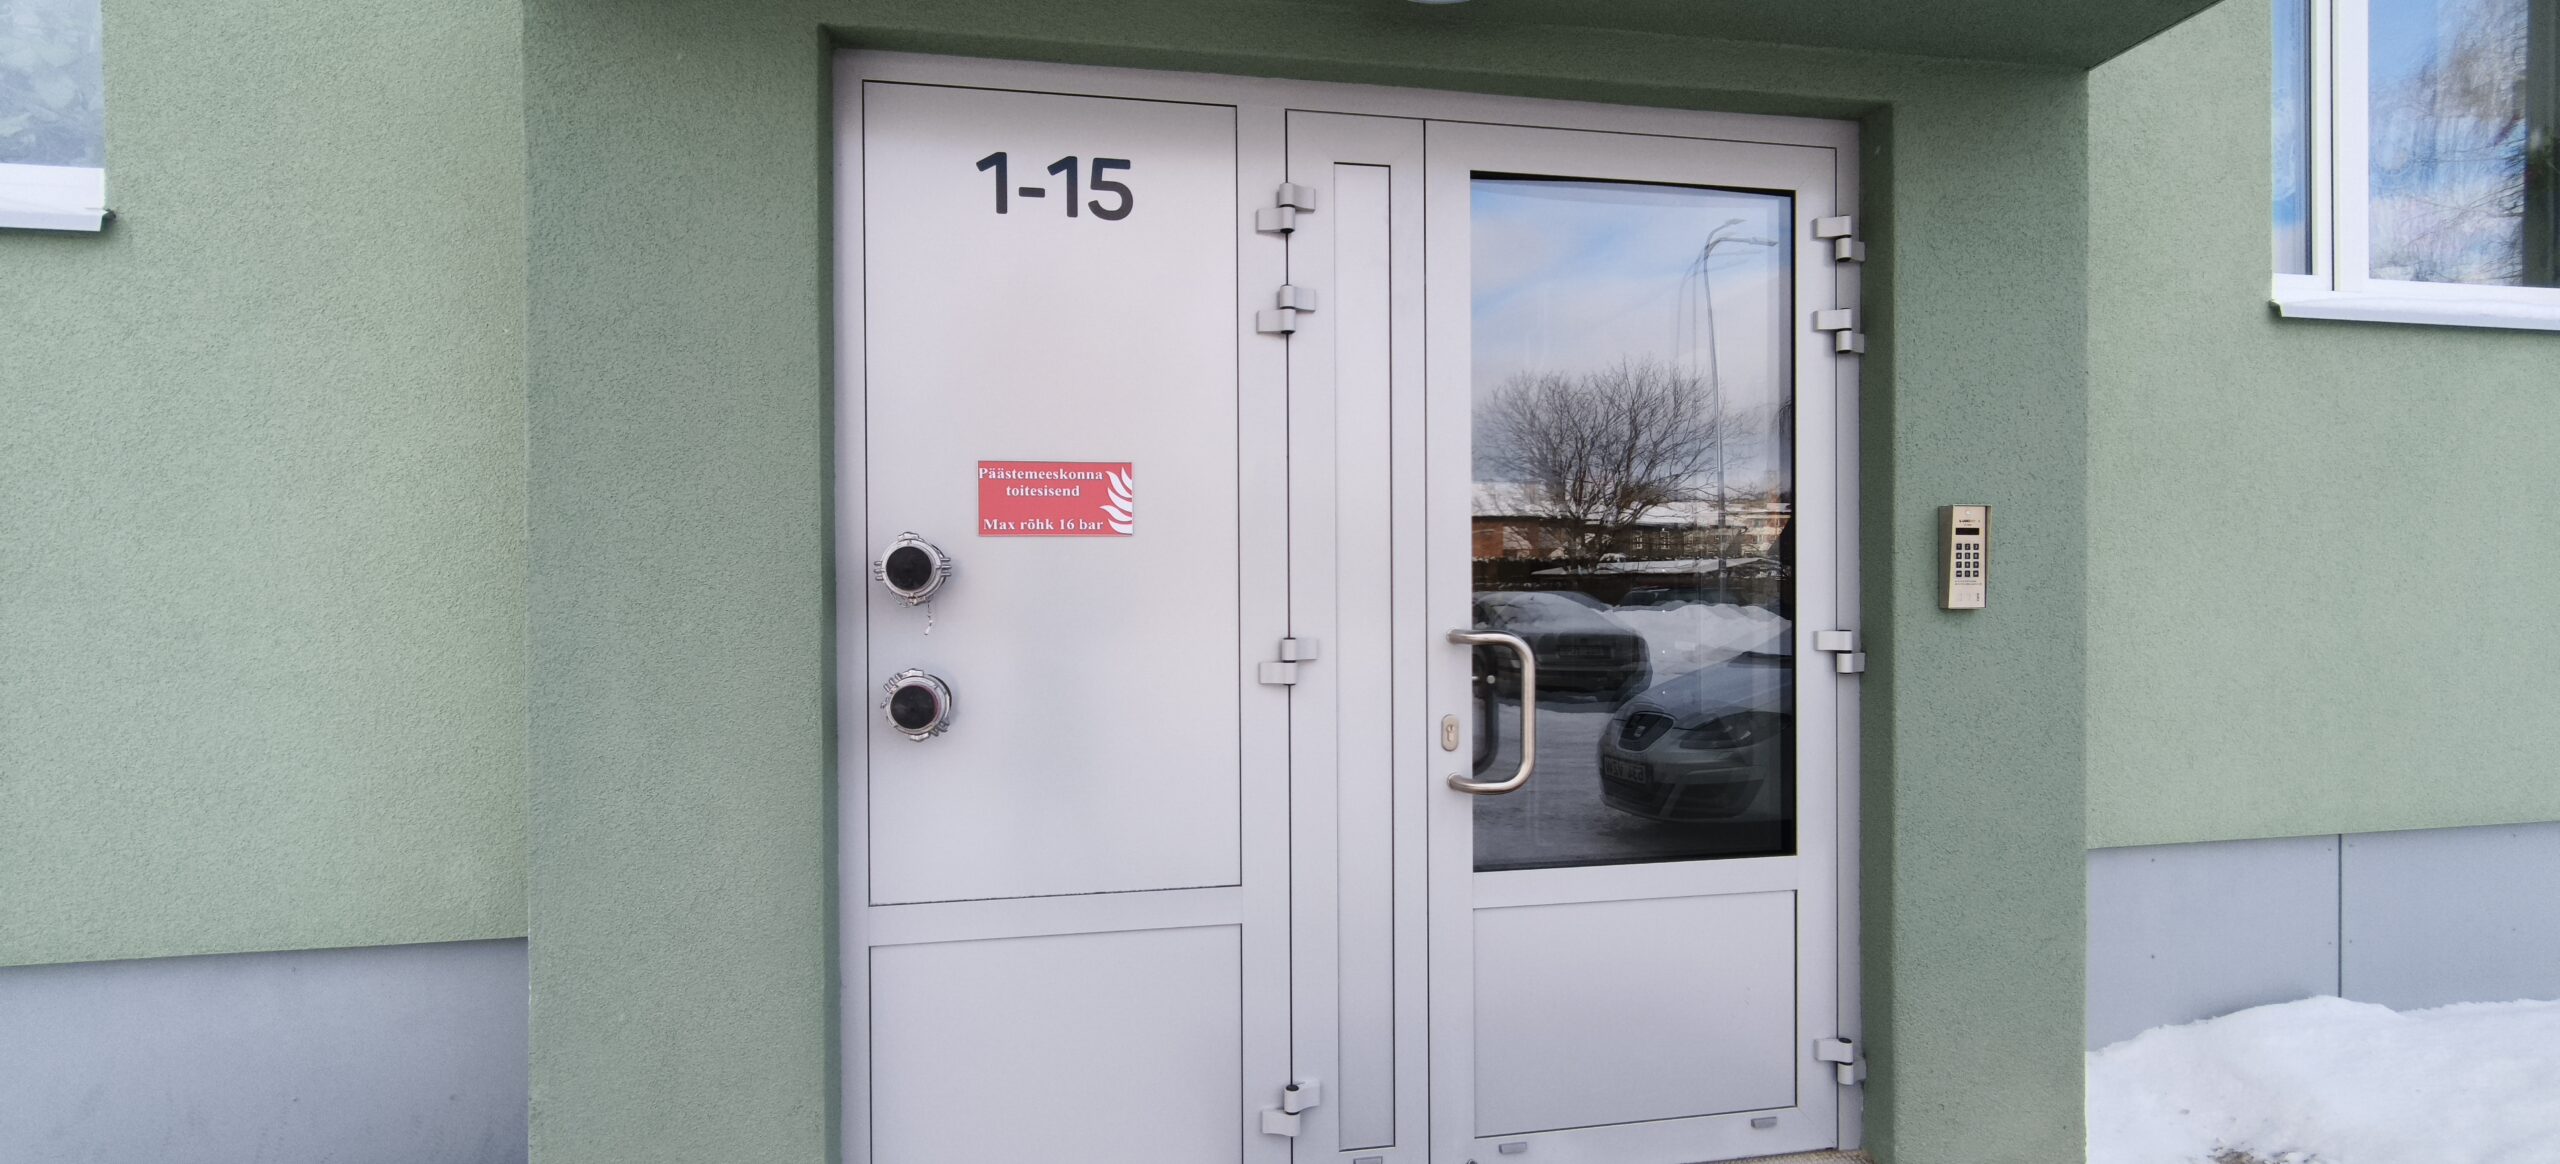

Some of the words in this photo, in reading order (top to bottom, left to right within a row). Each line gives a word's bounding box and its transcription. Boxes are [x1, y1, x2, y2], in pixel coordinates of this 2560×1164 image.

[976, 152, 1133, 221] 1-15
[978, 467, 1104, 480] Päästemeeskonna
[1006, 484, 1080, 497] toitesisend
[983, 518, 1016, 530] Max
[1020, 518, 1054, 530] rõhk
[1059, 518, 1075, 530] 16
[1079, 518, 1104, 530] bar
